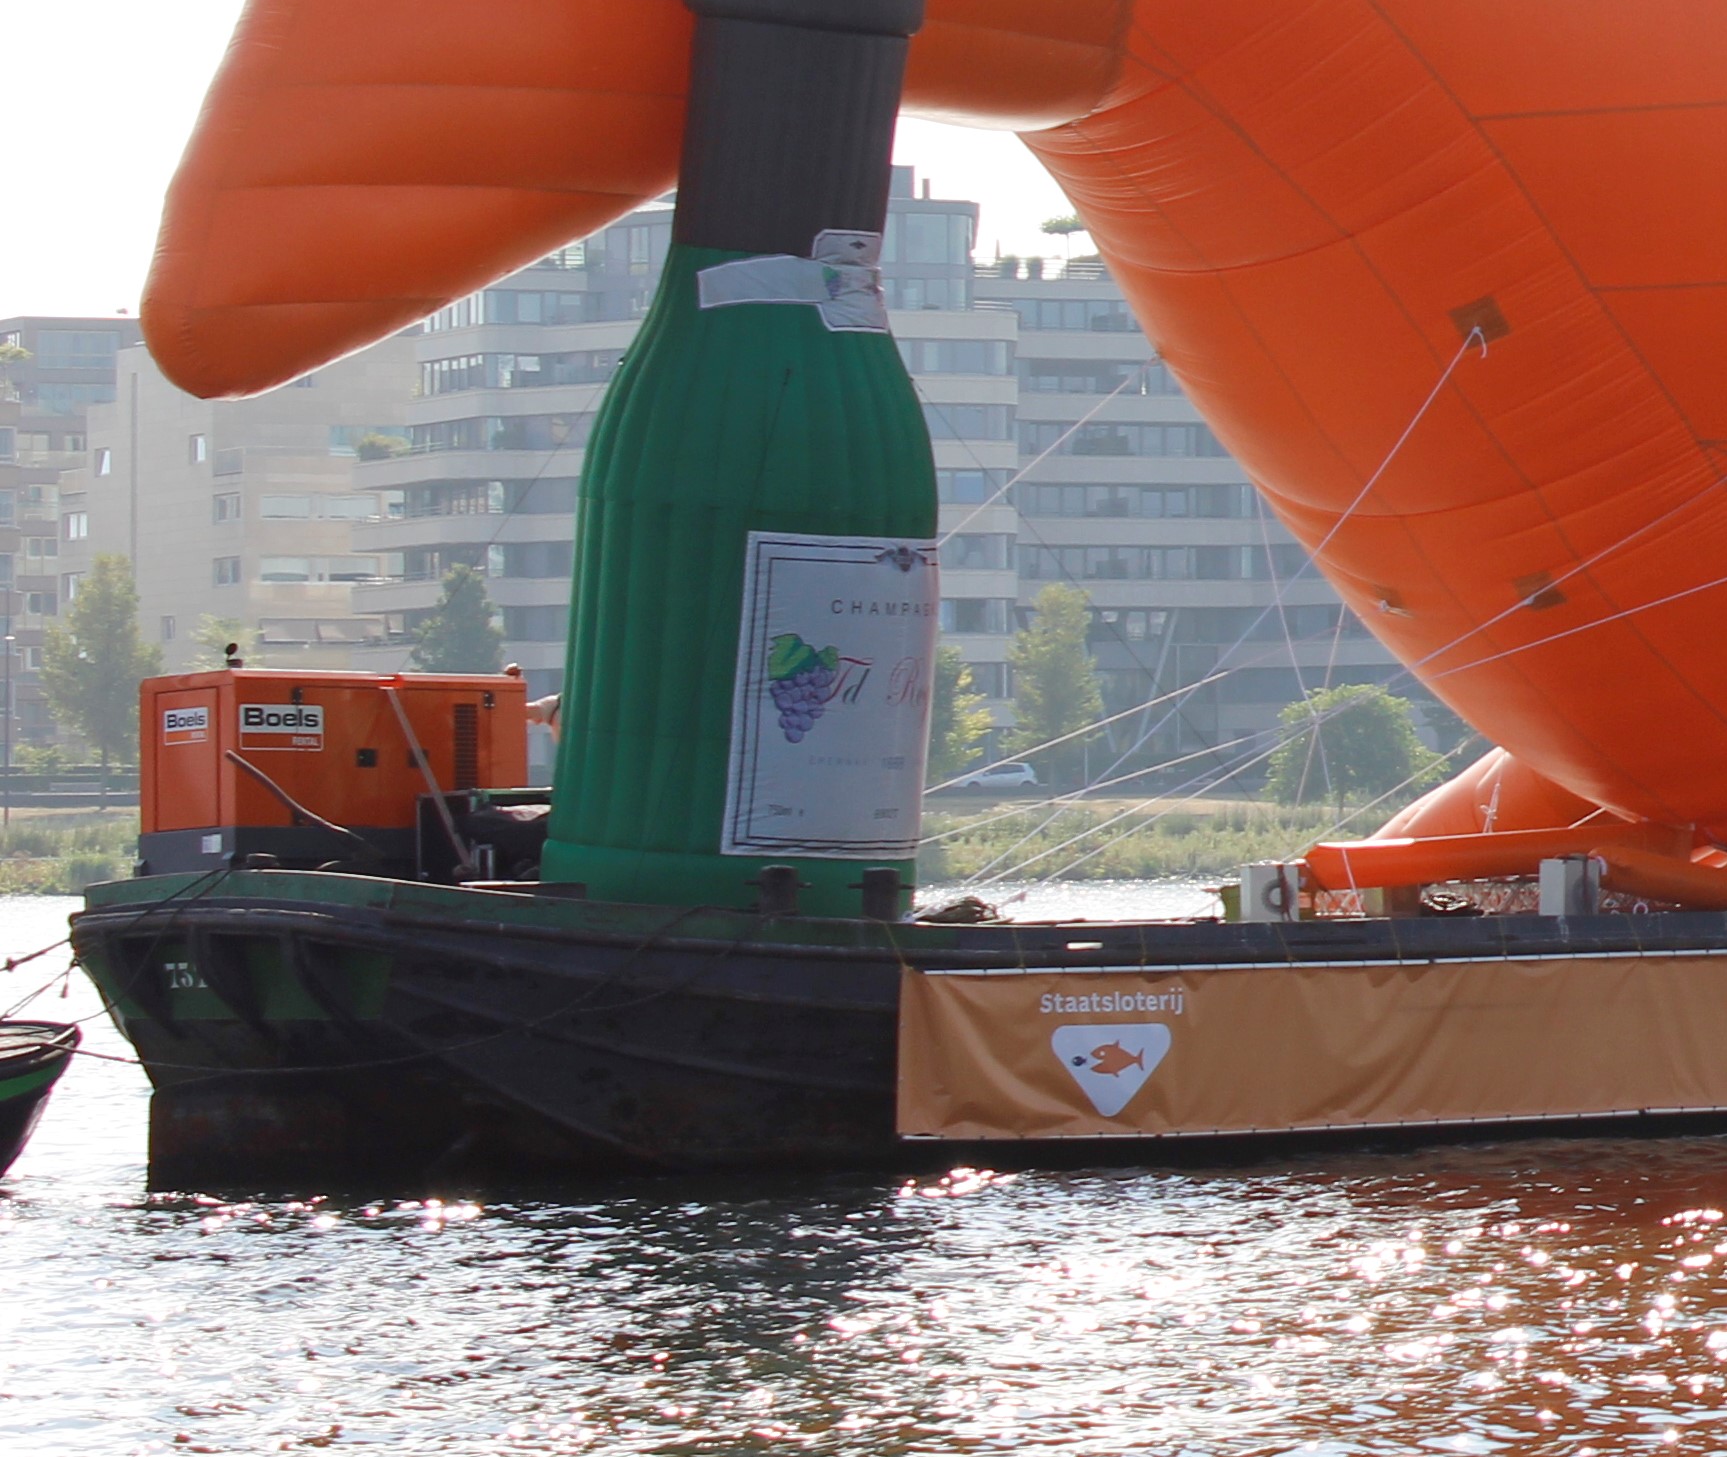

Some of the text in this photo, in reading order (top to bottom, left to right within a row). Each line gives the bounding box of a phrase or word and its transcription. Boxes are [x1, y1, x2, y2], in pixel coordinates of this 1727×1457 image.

[166, 711, 206, 729] Boels
[244, 707, 319, 728] Boels
[1039, 987, 1184, 1016] Staatsloterij
